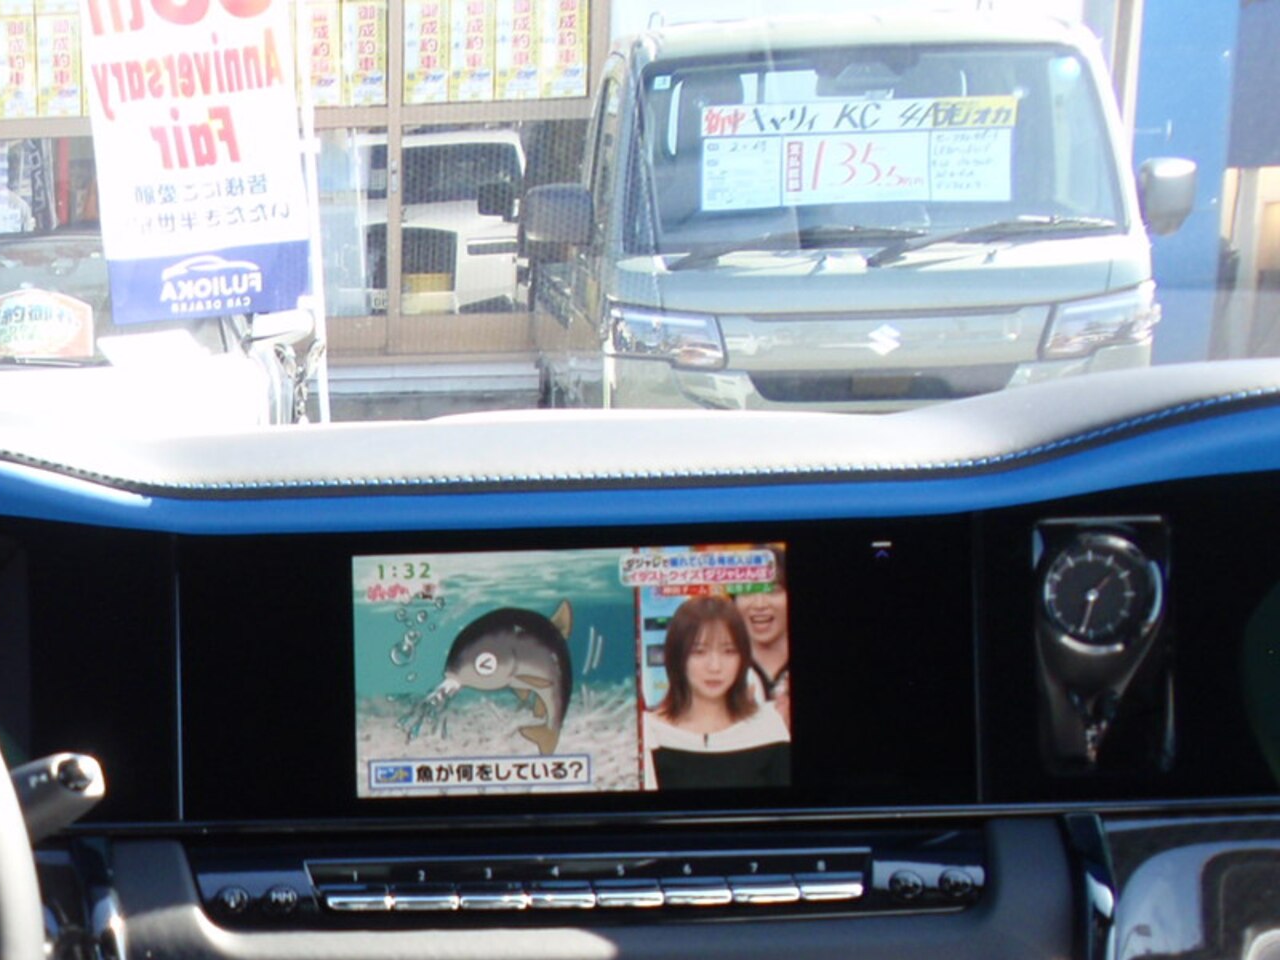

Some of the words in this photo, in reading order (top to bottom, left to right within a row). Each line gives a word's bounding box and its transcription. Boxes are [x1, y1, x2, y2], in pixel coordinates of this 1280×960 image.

[378, 562, 431, 580] 1:32
[417, 761, 583, 783] 魚が何をしている?
